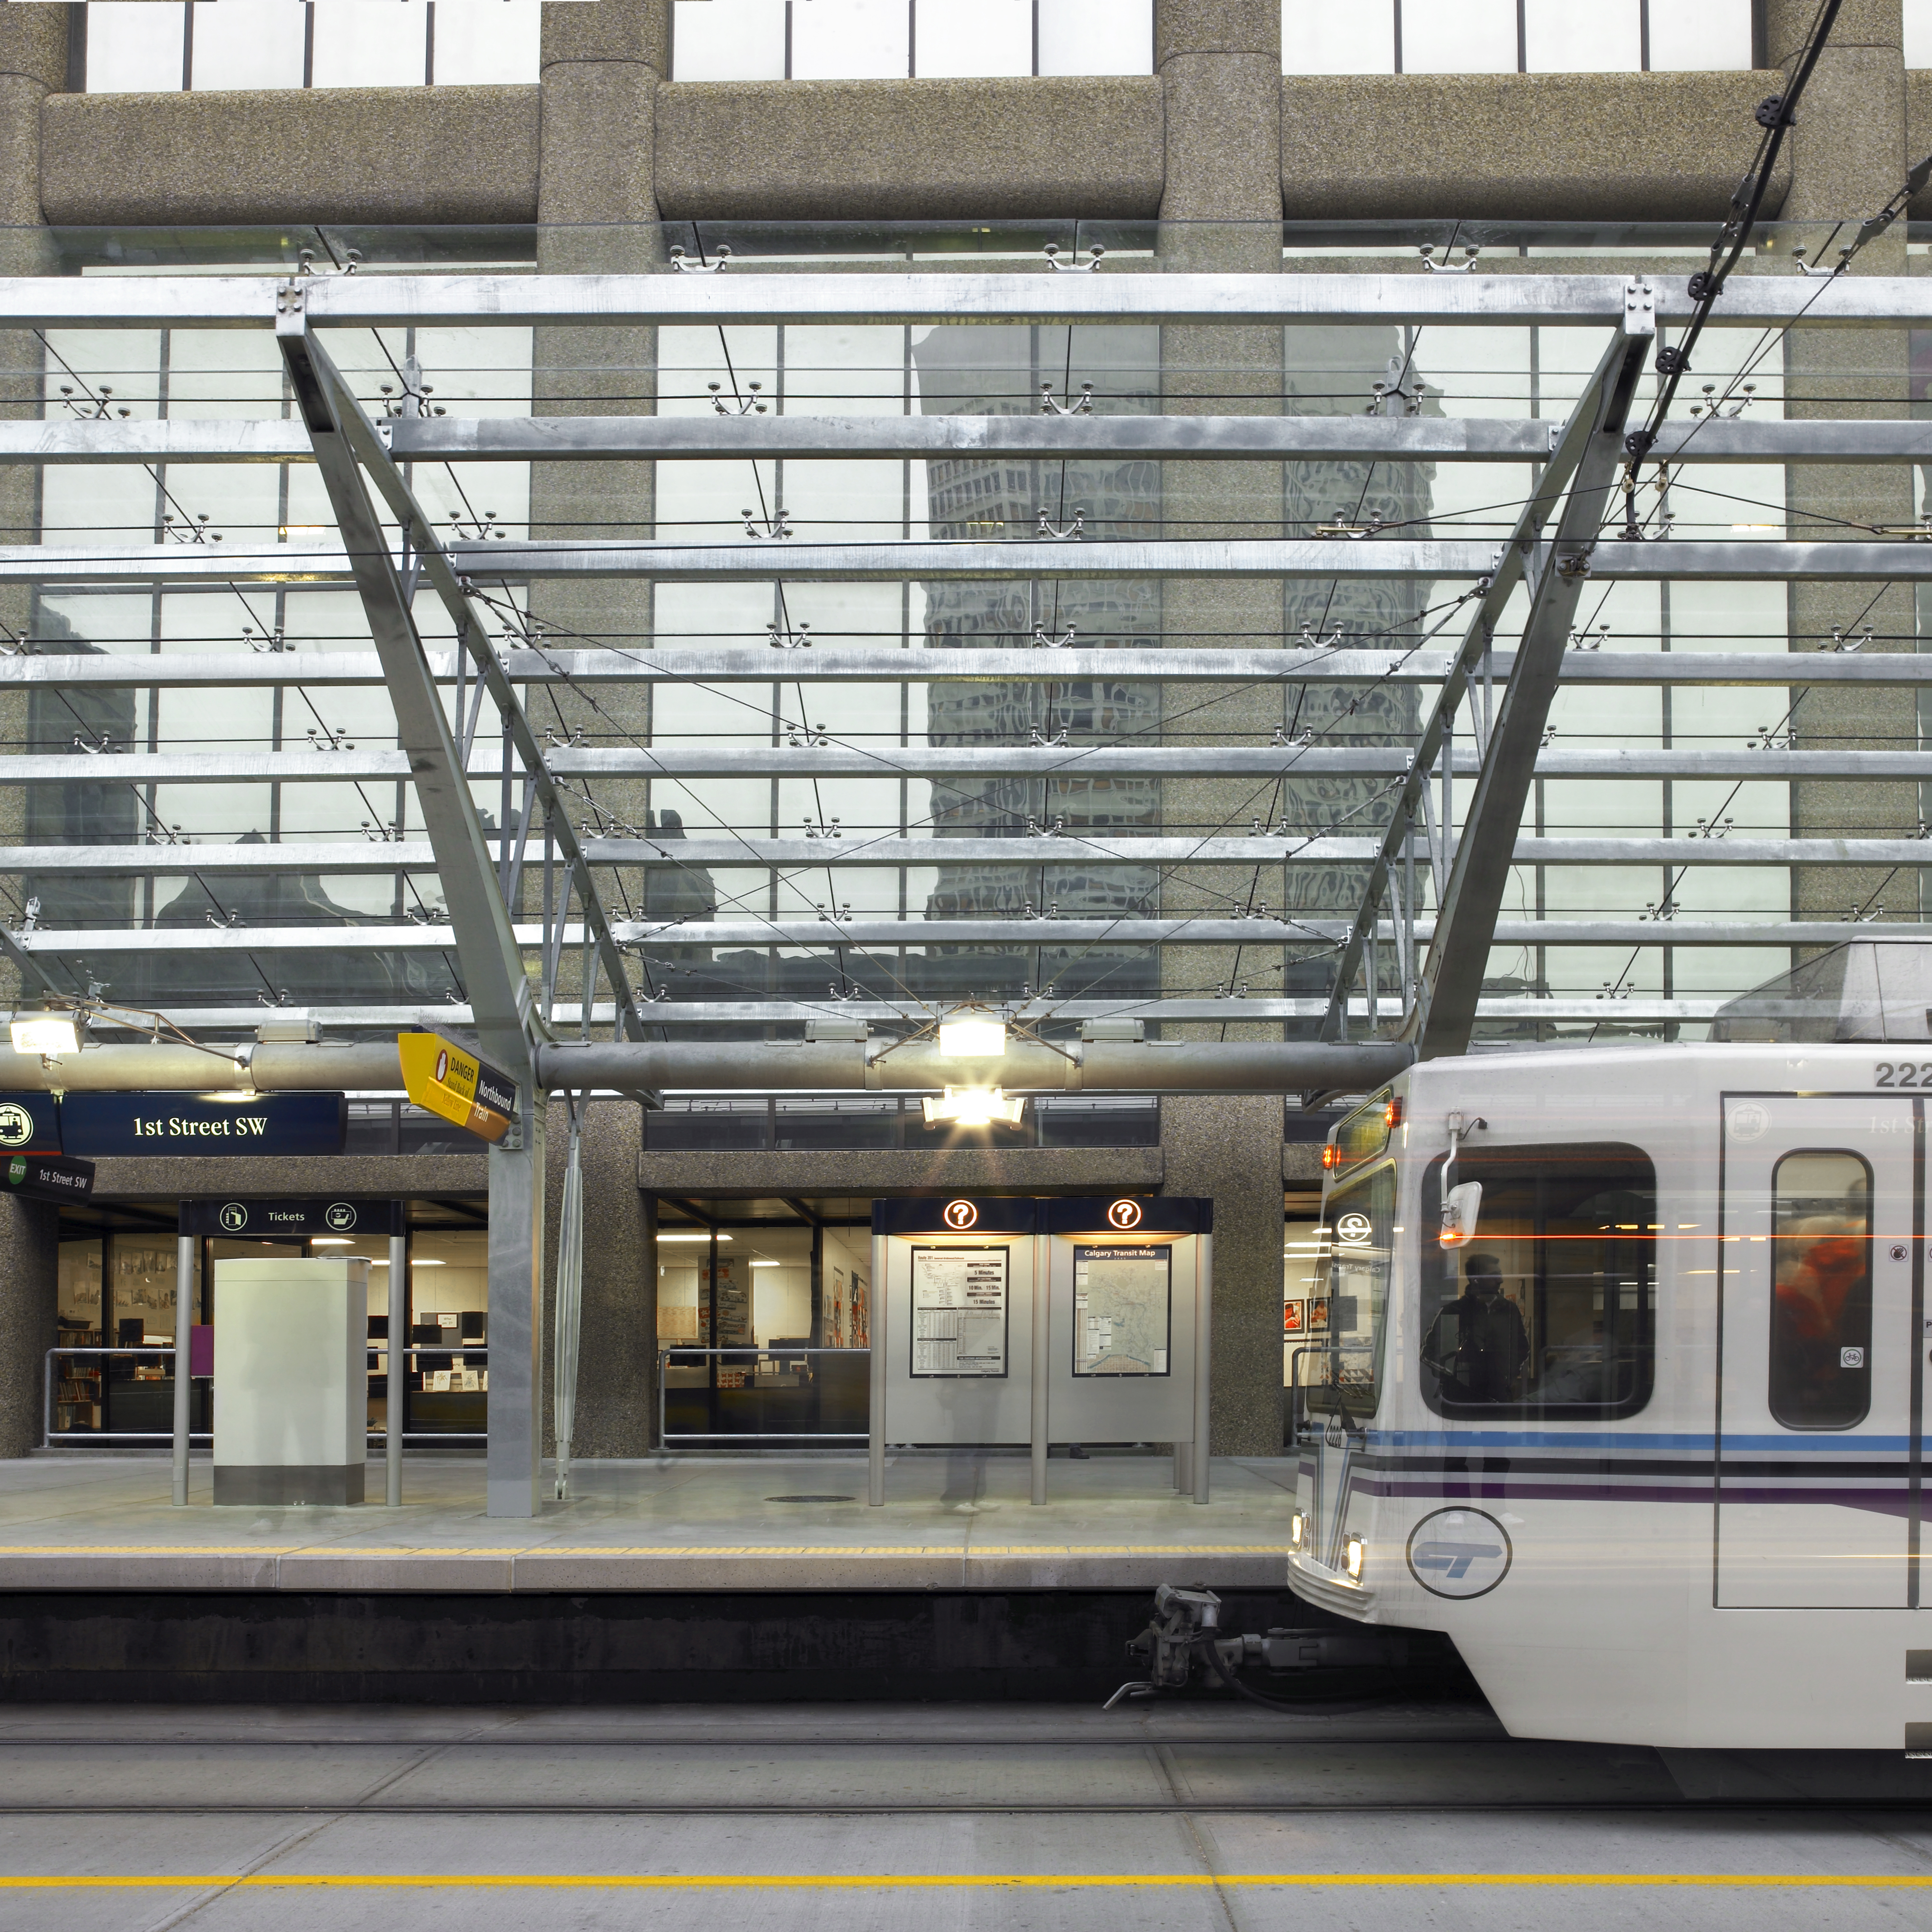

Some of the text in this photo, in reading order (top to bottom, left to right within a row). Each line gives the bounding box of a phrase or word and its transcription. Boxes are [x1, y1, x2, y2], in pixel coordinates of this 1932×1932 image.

[450, 1057, 474, 1083] DANGER
[479, 1080, 512, 1111] Northbound
[474, 1101, 489, 1122] Train
[134, 1117, 268, 1136] 1st Street SW
[9, 1163, 26, 1175] EXIT
[39, 1169, 87, 1189] 1st Street SW
[268, 1212, 305, 1221] Tickets
[1084, 1250, 1111, 1258] Calgary
[1328, 1425, 1342, 1448] 2228
